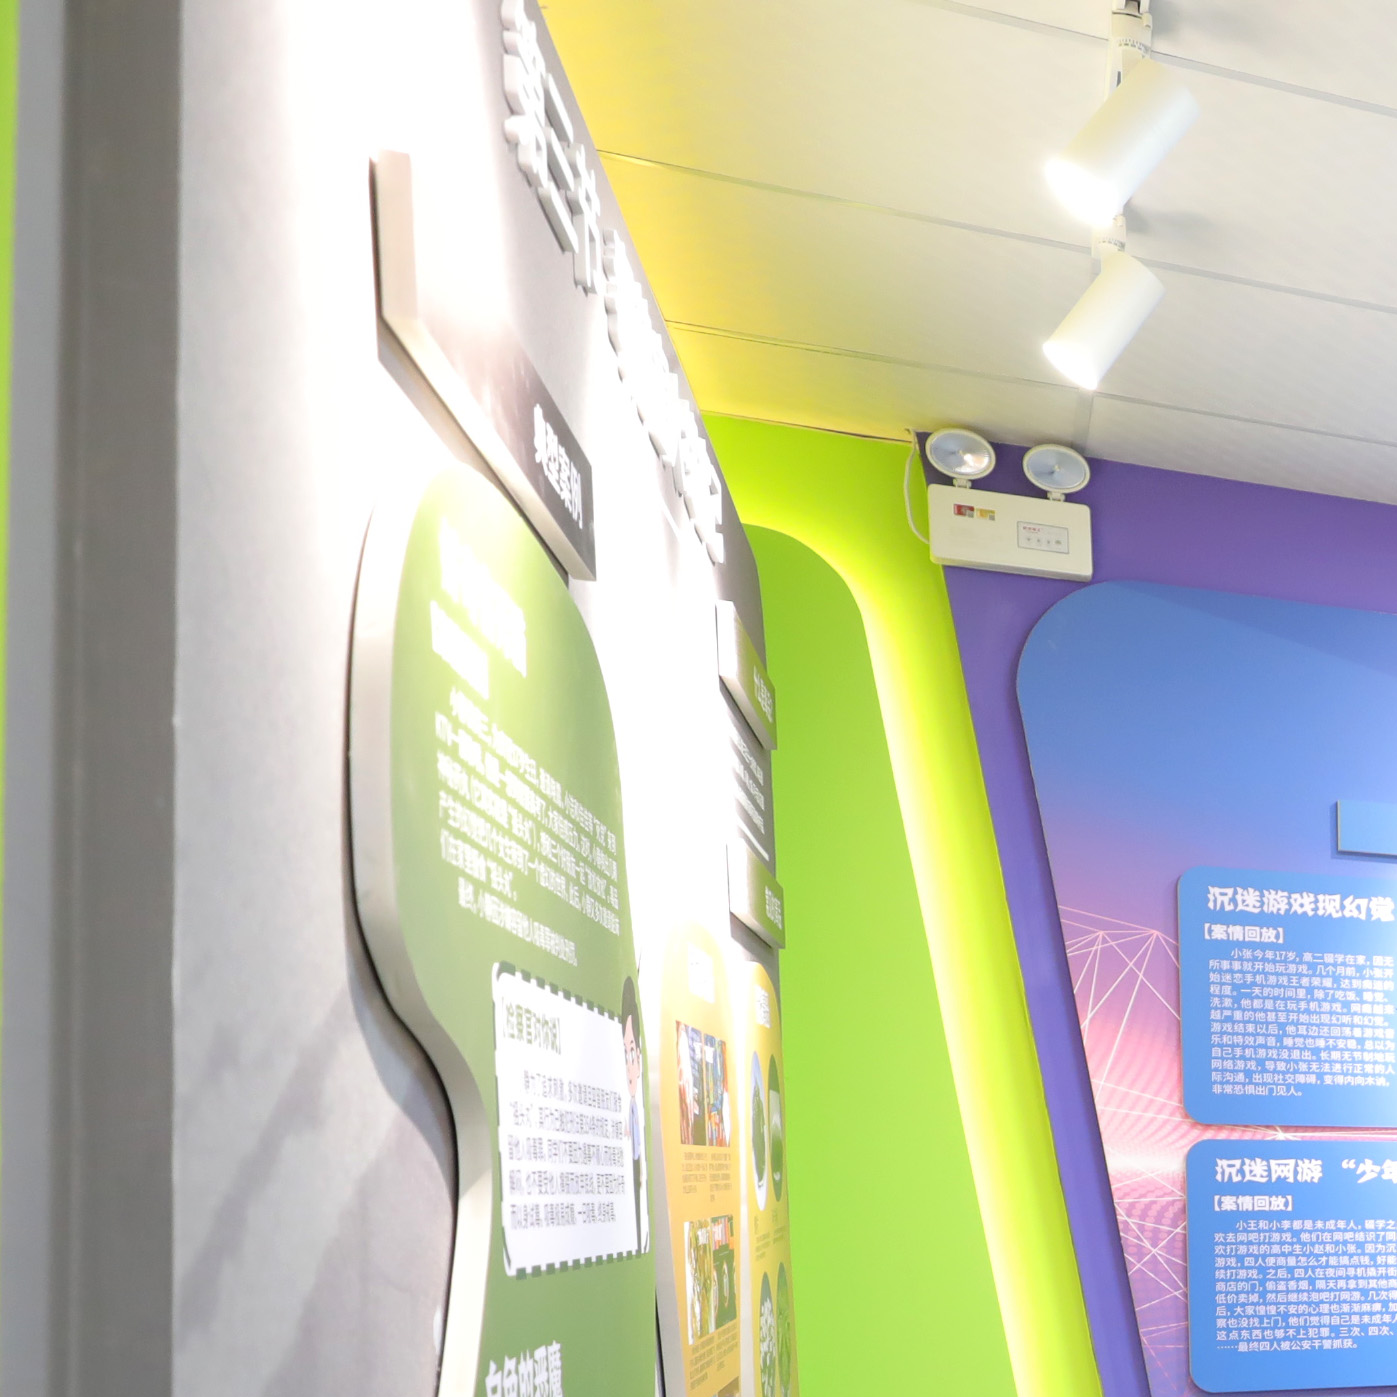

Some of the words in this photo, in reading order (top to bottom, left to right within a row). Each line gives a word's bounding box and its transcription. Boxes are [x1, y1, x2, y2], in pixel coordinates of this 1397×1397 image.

[533, 403, 582, 529] 典型案例
[1207, 885, 1396, 921] 沉迷游戏现幻觉
[1202, 922, 1286, 944] 【案情回放】
[1214, 1157, 1323, 1184] 沉迷网游
[1213, 1195, 1294, 1212] 【案情回放】
